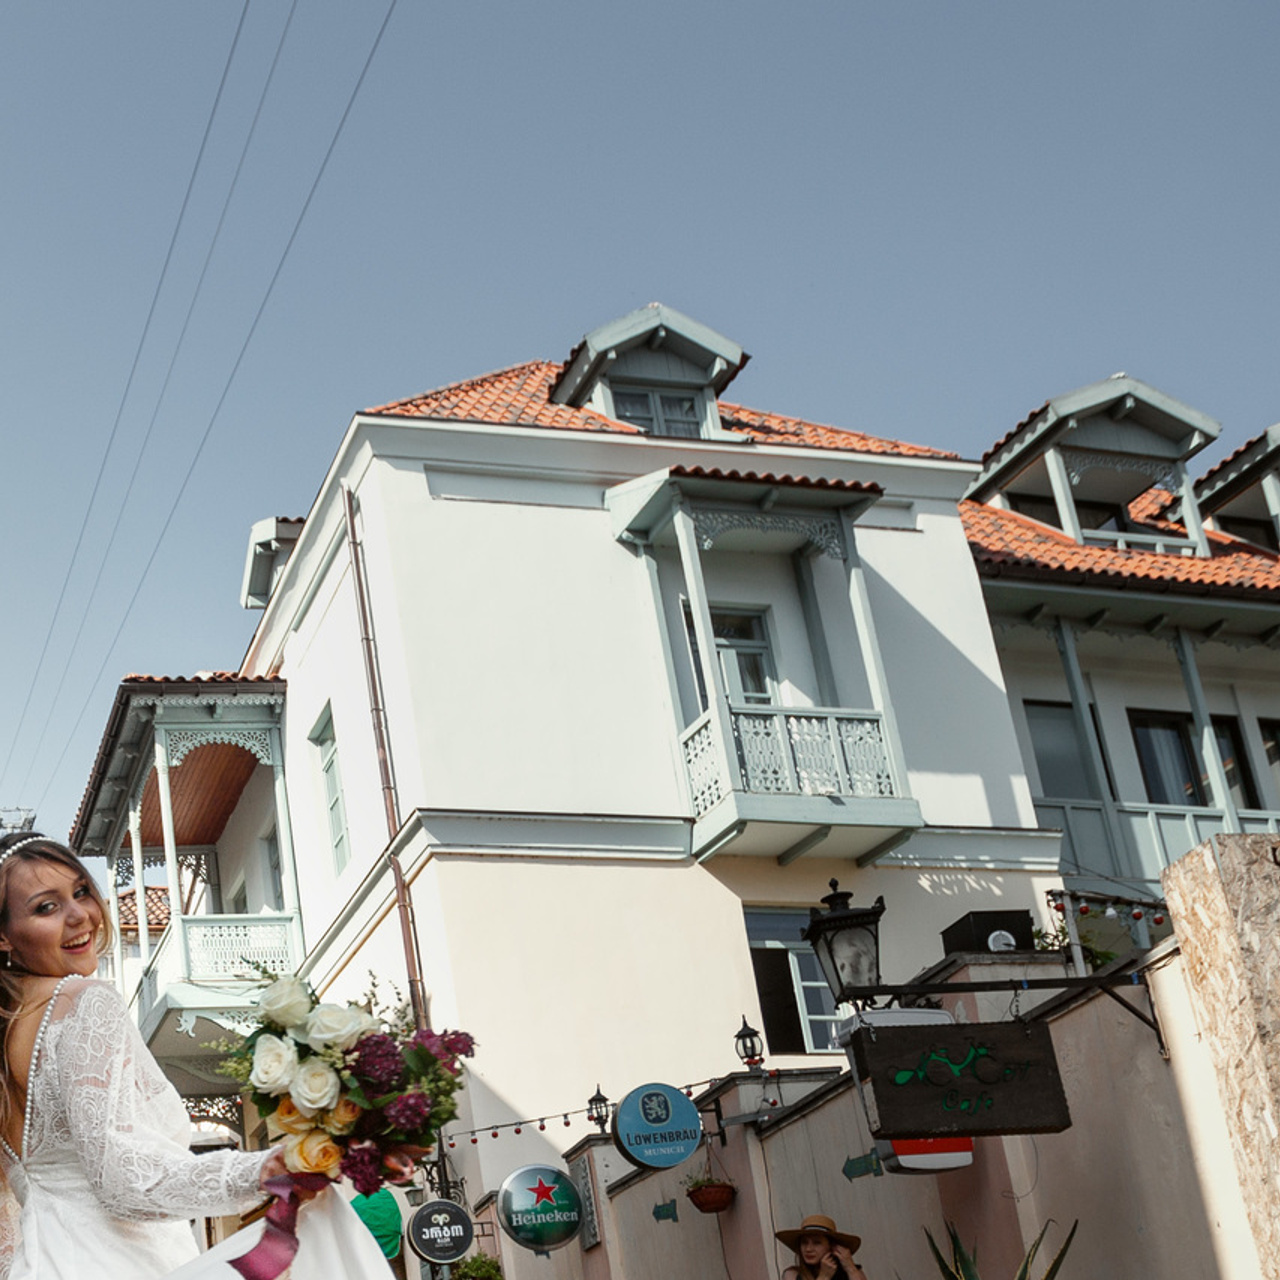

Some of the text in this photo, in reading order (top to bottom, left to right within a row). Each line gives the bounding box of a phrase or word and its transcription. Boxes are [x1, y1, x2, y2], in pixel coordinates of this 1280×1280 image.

[626, 1128, 698, 1147] LÖWENBRÄU
[643, 1145, 685, 1157] MUNICH
[511, 1210, 579, 1227] Heineken
